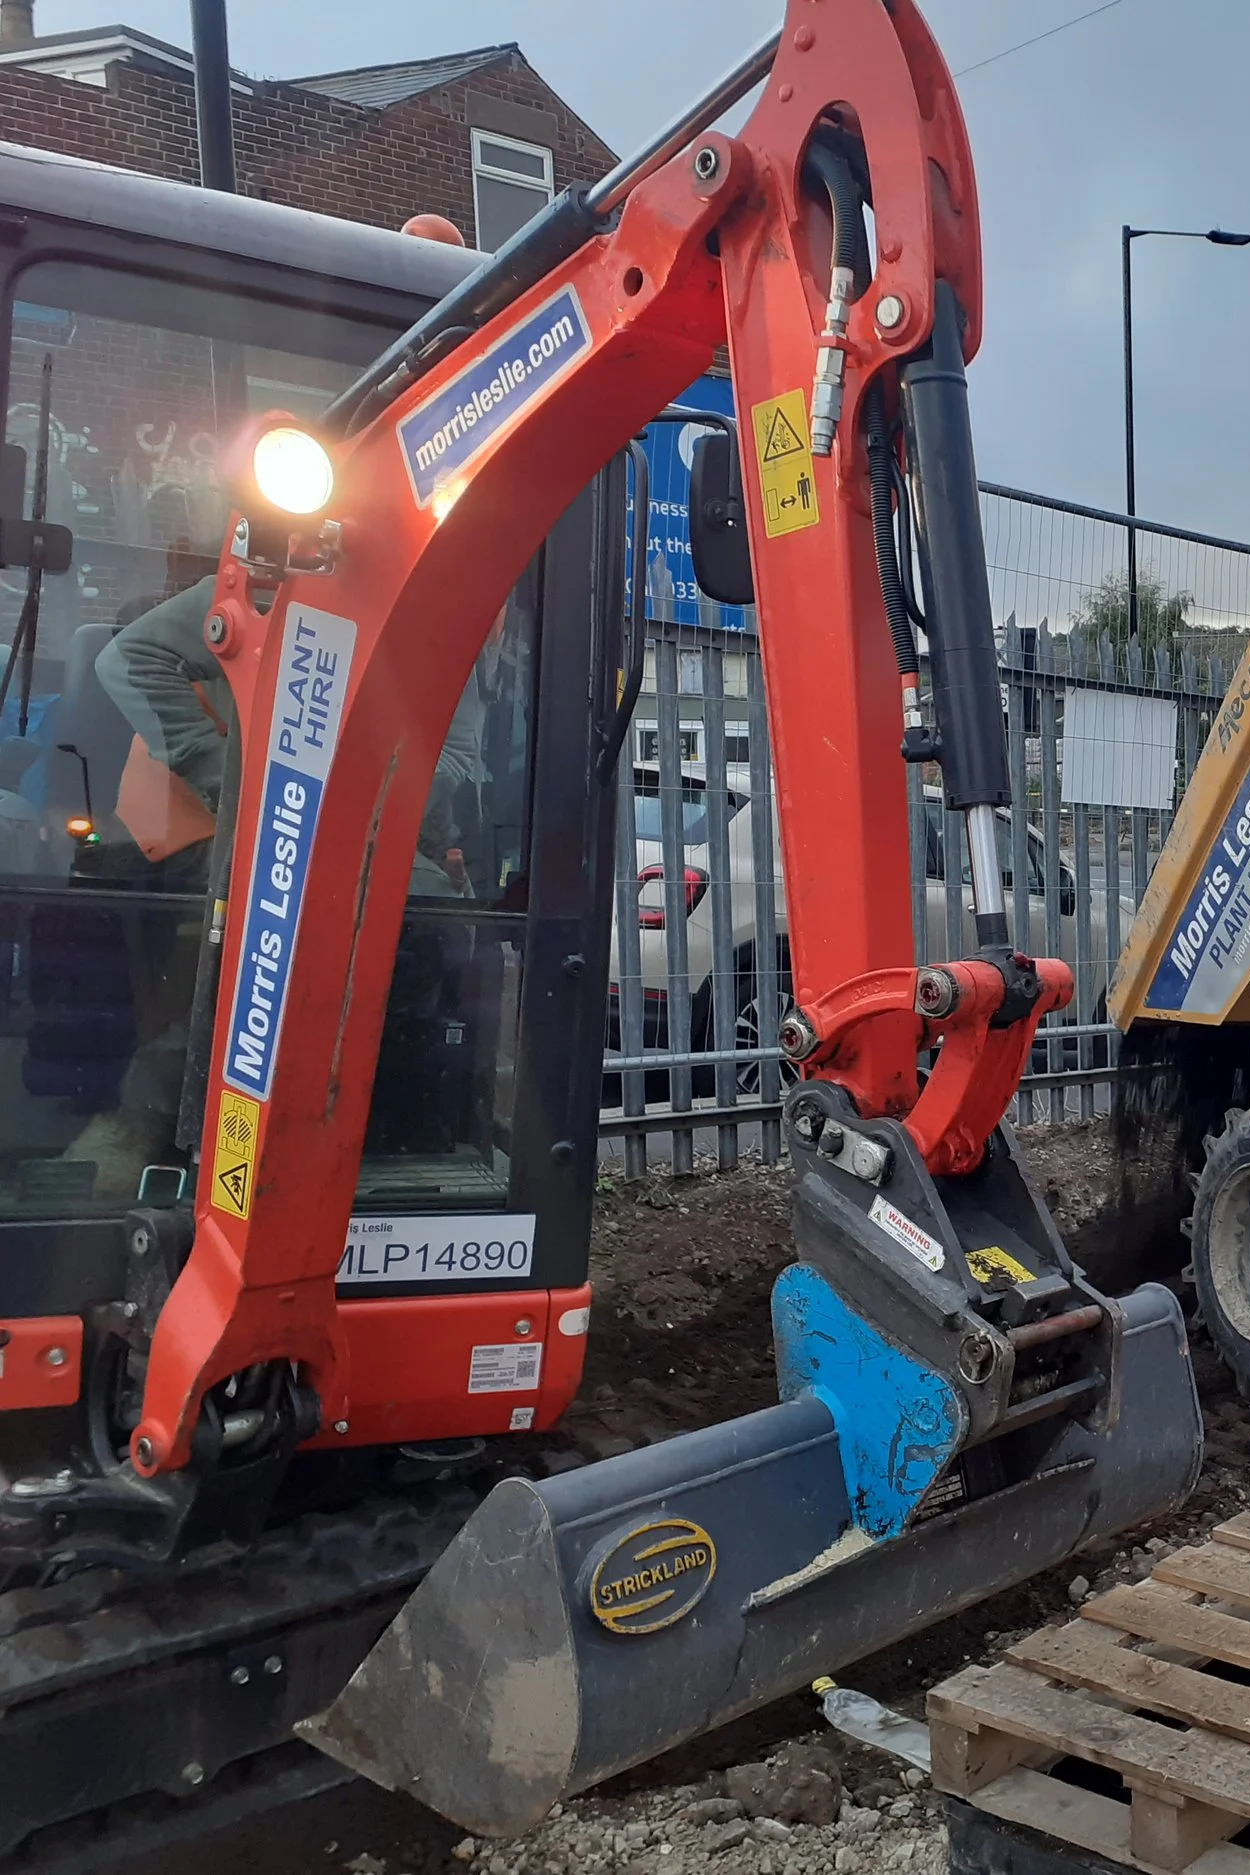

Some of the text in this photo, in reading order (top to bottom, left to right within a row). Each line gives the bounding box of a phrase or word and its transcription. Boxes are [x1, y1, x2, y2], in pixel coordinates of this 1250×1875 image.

[414, 314, 576, 472] morrisleslie.com
[278, 616, 317, 757] PLANT
[304, 647, 338, 749] HIRE
[234, 780, 306, 1080] Morris Leslie
[1169, 863, 1231, 980] Morris
[361, 1222, 394, 1233] Leslie
[888, 1210, 931, 1250] WARNING
[600, 1549, 707, 1604] STRICKLAND
